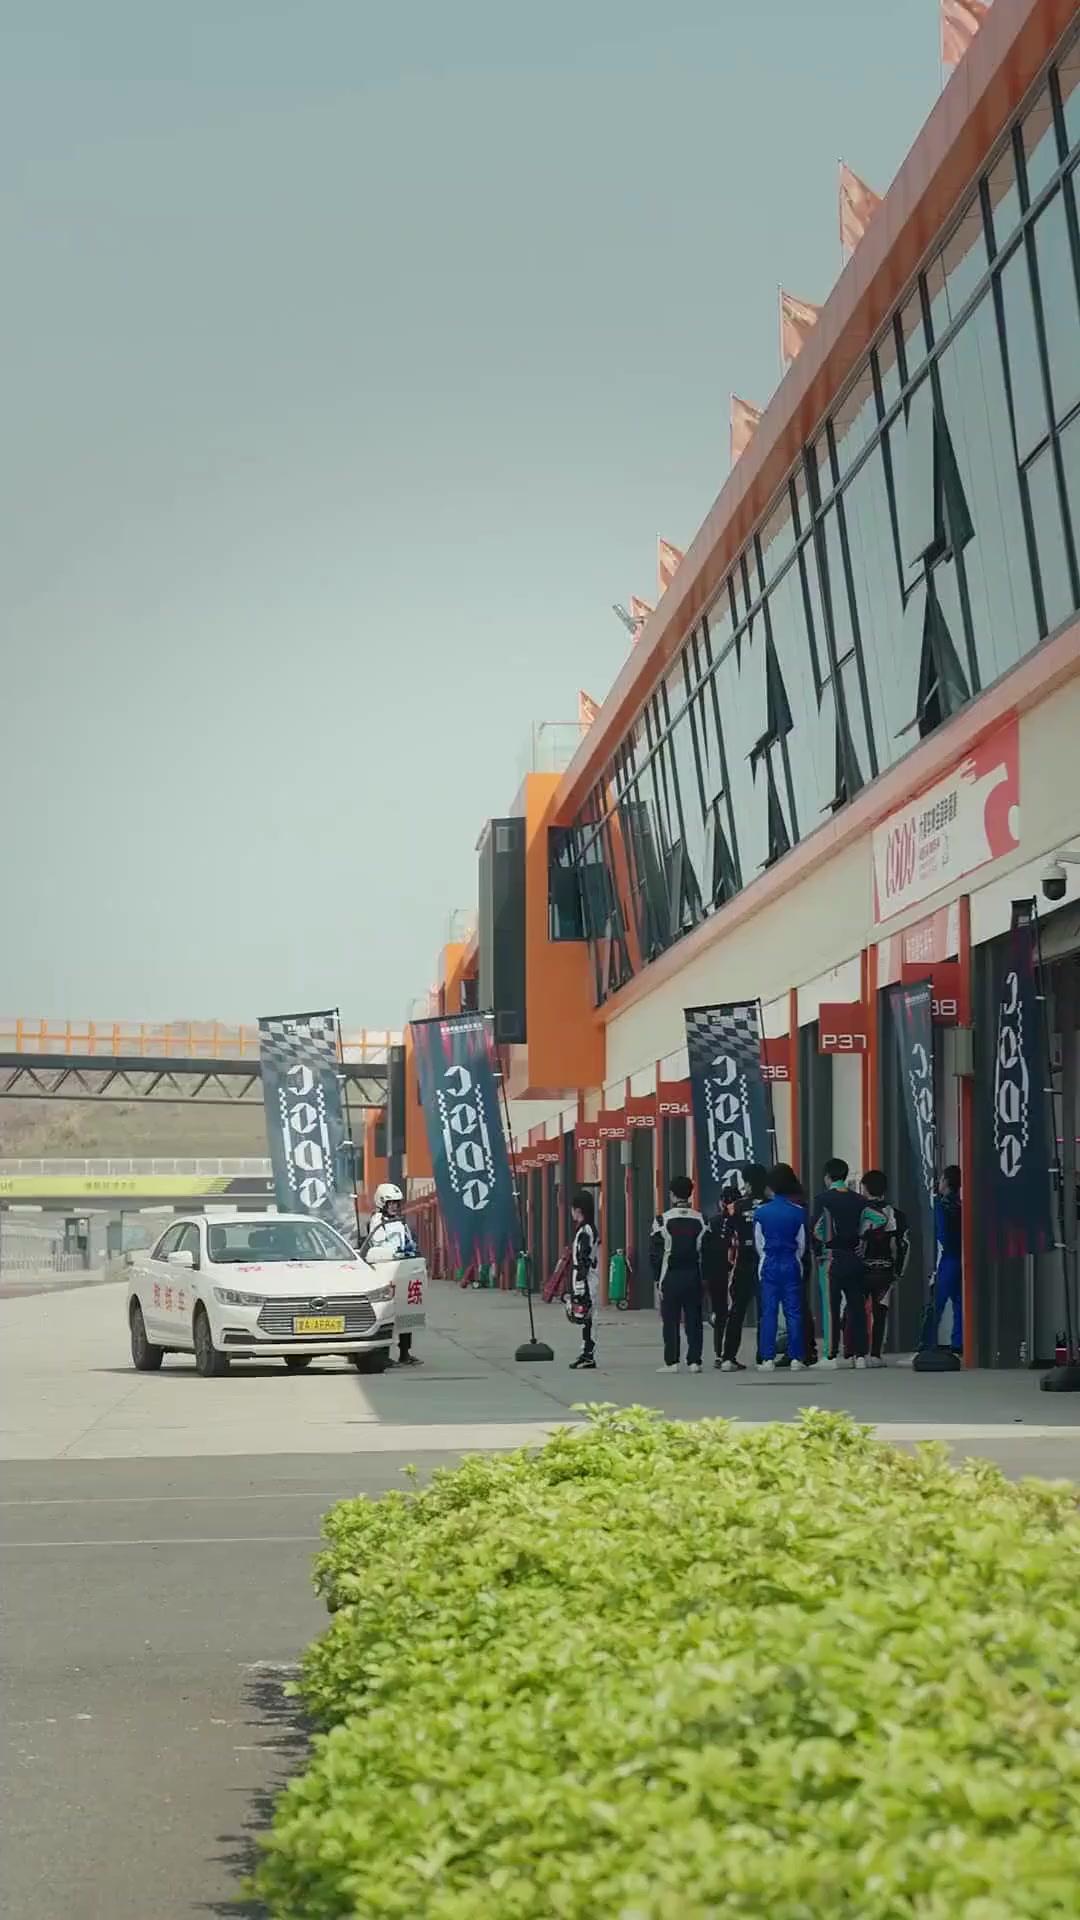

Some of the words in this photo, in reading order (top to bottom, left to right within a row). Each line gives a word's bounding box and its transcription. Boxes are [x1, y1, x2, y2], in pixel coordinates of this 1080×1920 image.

[822, 1033, 867, 1049] P37
[659, 1103, 690, 1114] P34
[626, 1116, 656, 1126] P33
[599, 1128, 625, 1137] P32
[578, 1138, 601, 1148] P31
